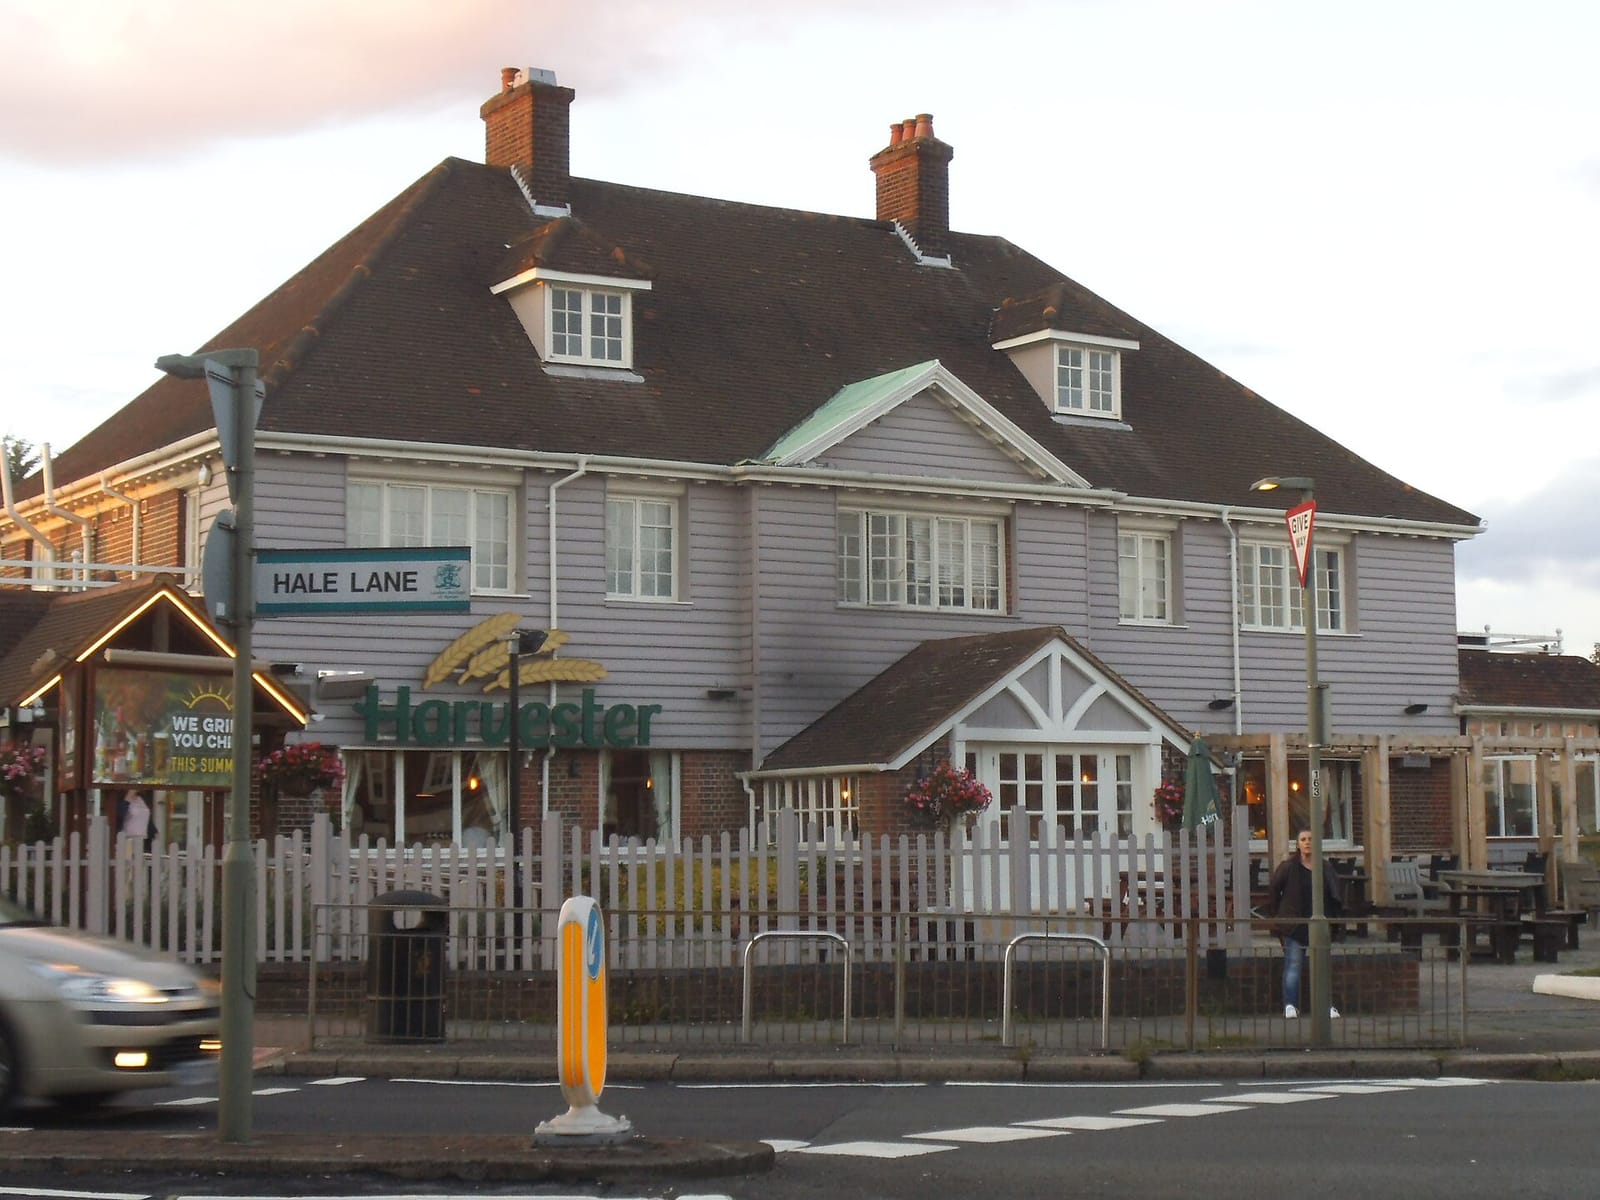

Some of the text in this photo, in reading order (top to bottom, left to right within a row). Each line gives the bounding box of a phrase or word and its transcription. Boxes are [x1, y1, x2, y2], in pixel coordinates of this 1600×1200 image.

[1292, 514, 1308, 533] GIVE
[273, 571, 418, 594] HALE LANE
[172, 716, 198, 731] WE
[352, 685, 663, 747] Harvester
[172, 733, 203, 747] YOU
[171, 757, 196, 772] THIS
